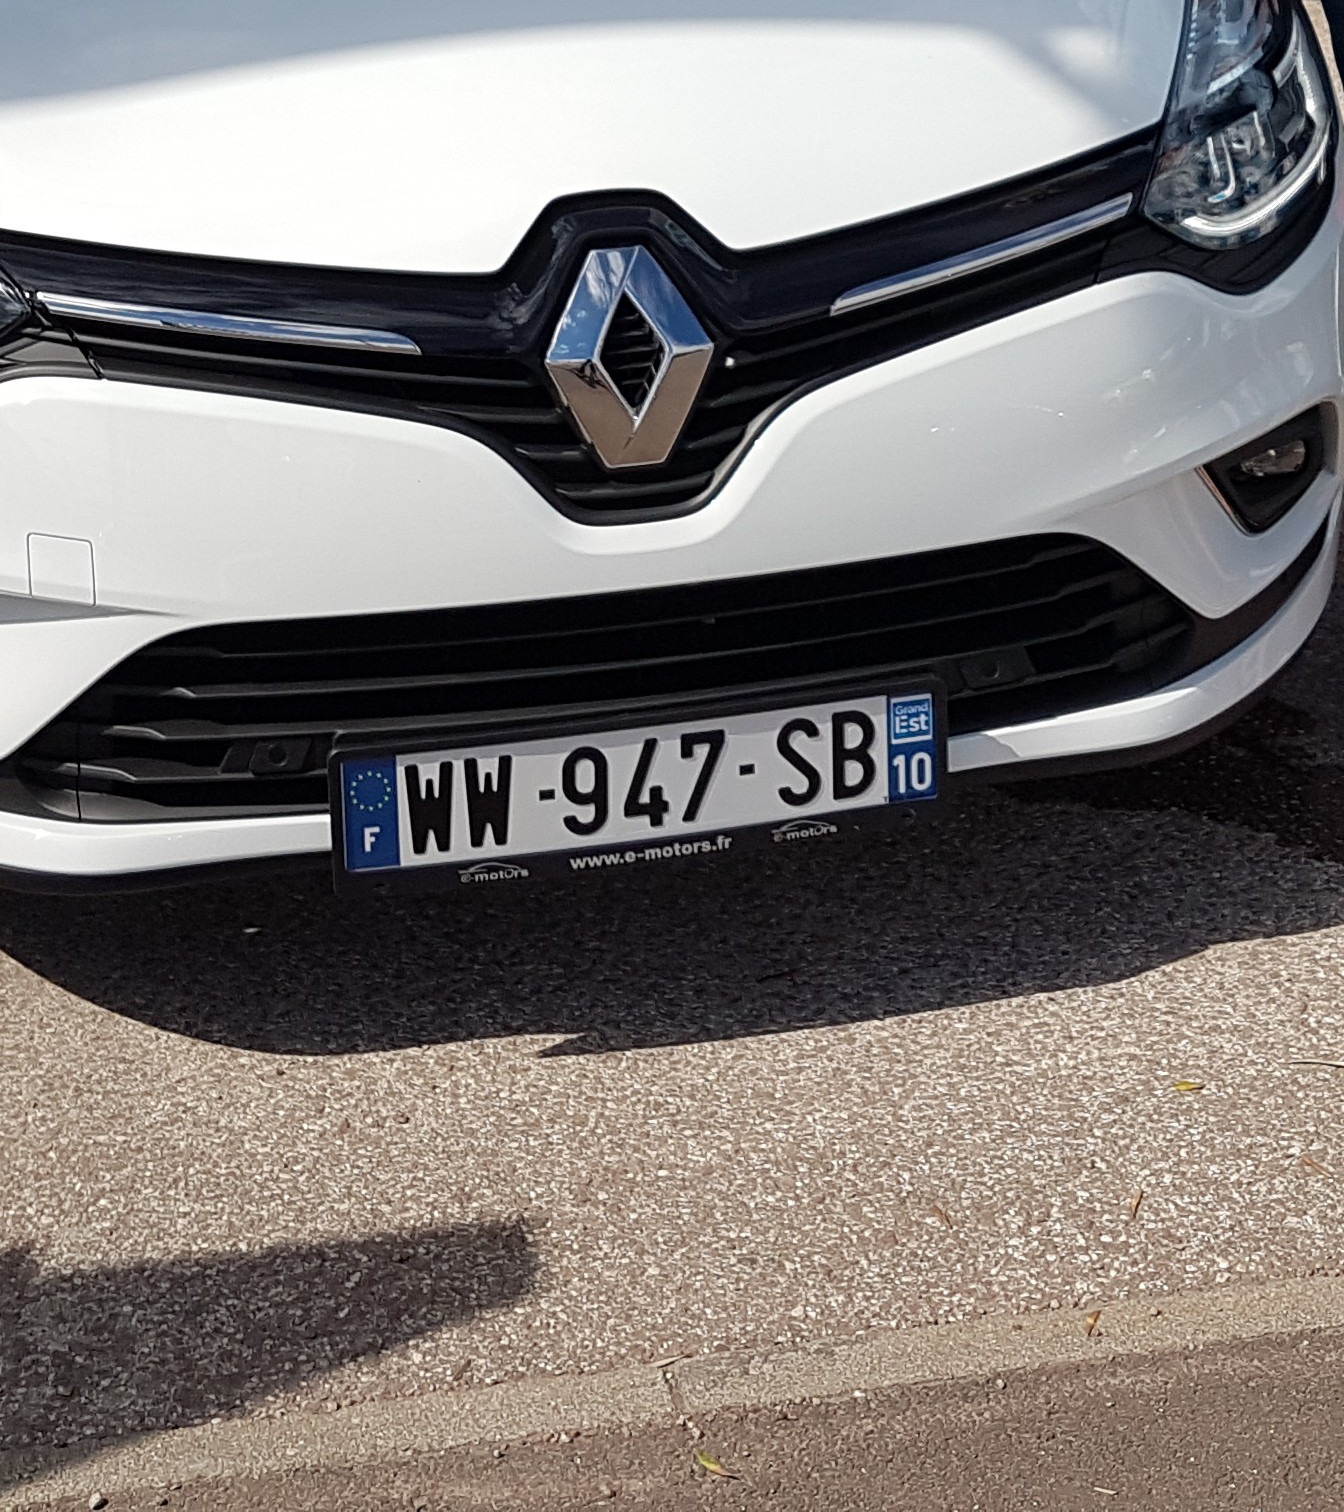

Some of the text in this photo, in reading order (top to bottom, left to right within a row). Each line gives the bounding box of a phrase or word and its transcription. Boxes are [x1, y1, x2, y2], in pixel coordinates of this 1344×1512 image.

[895, 702, 930, 715] Grand
[895, 713, 930, 734] Est
[892, 751, 932, 794] 10
[363, 826, 381, 853] F
[569, 835, 733, 870] www.e-motors.fr
